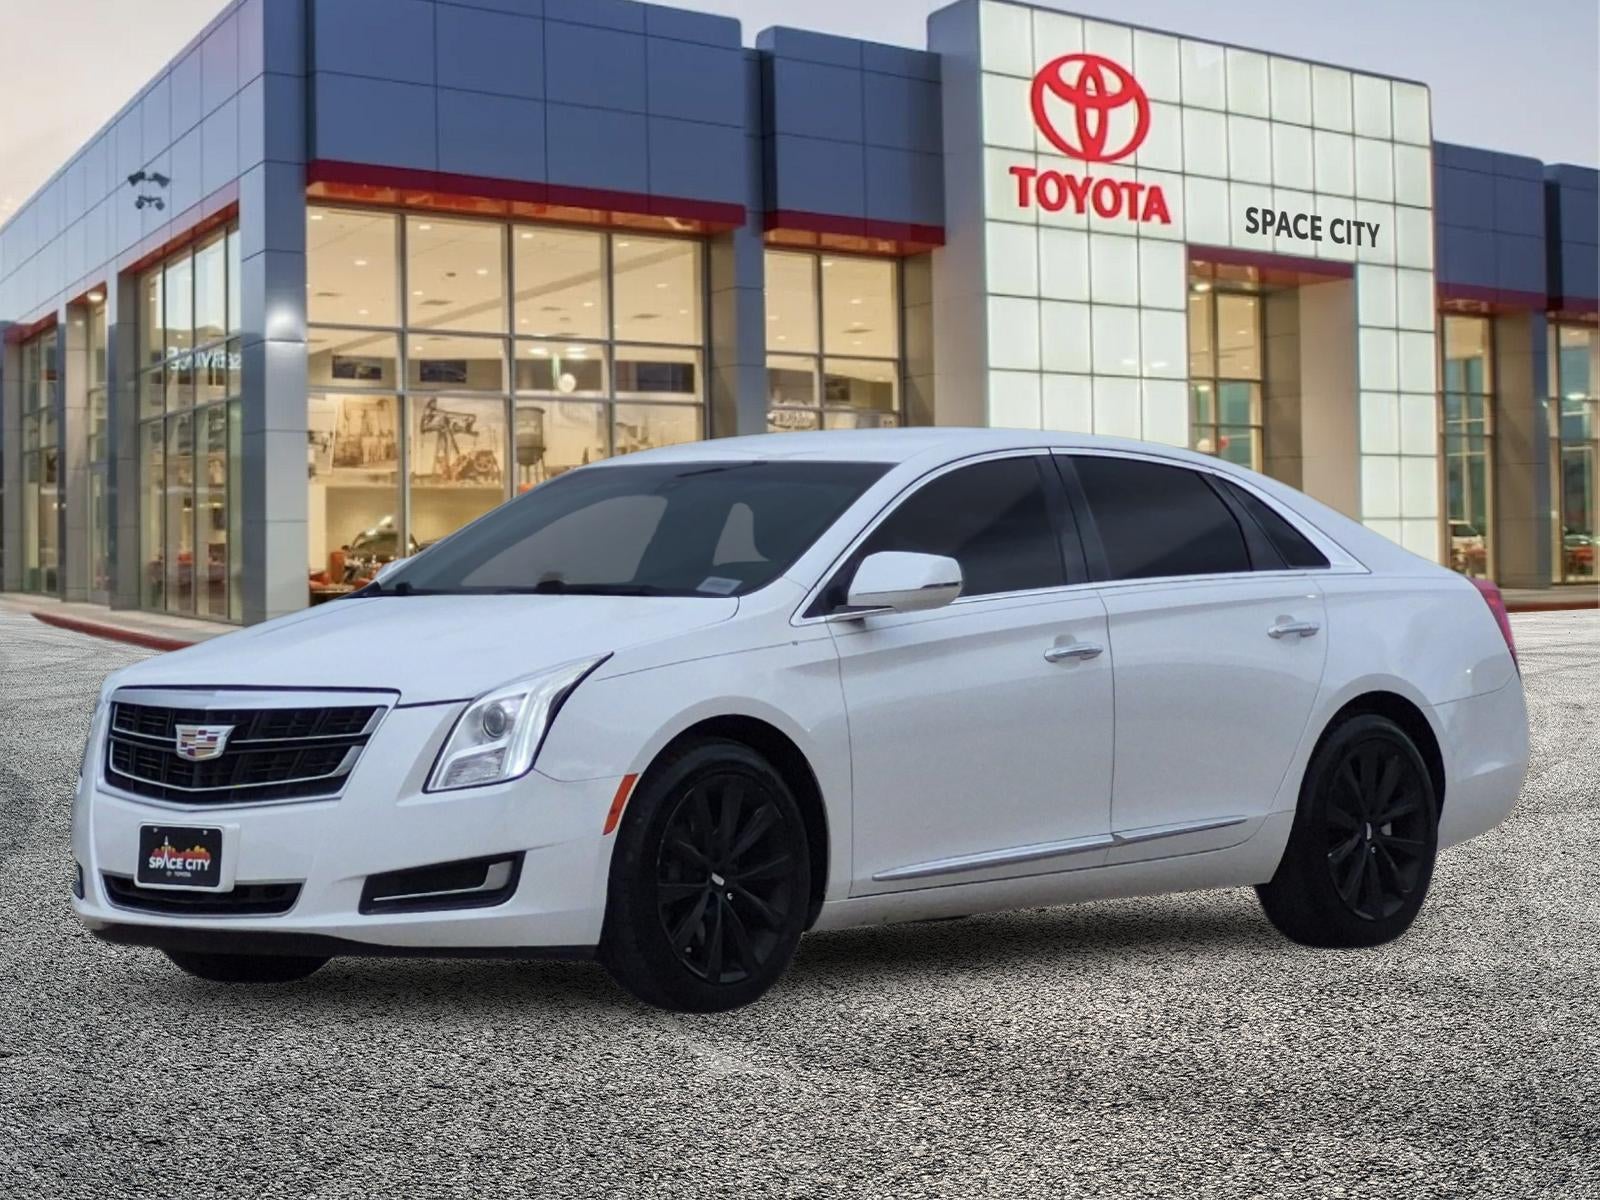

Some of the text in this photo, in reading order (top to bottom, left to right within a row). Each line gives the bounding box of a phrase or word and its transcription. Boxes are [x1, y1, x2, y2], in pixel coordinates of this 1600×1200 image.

[1009, 167, 1171, 224] TOYOTA
[1245, 206, 1381, 248] SPACE CITY
[149, 856, 211, 871] SPACE CITY
